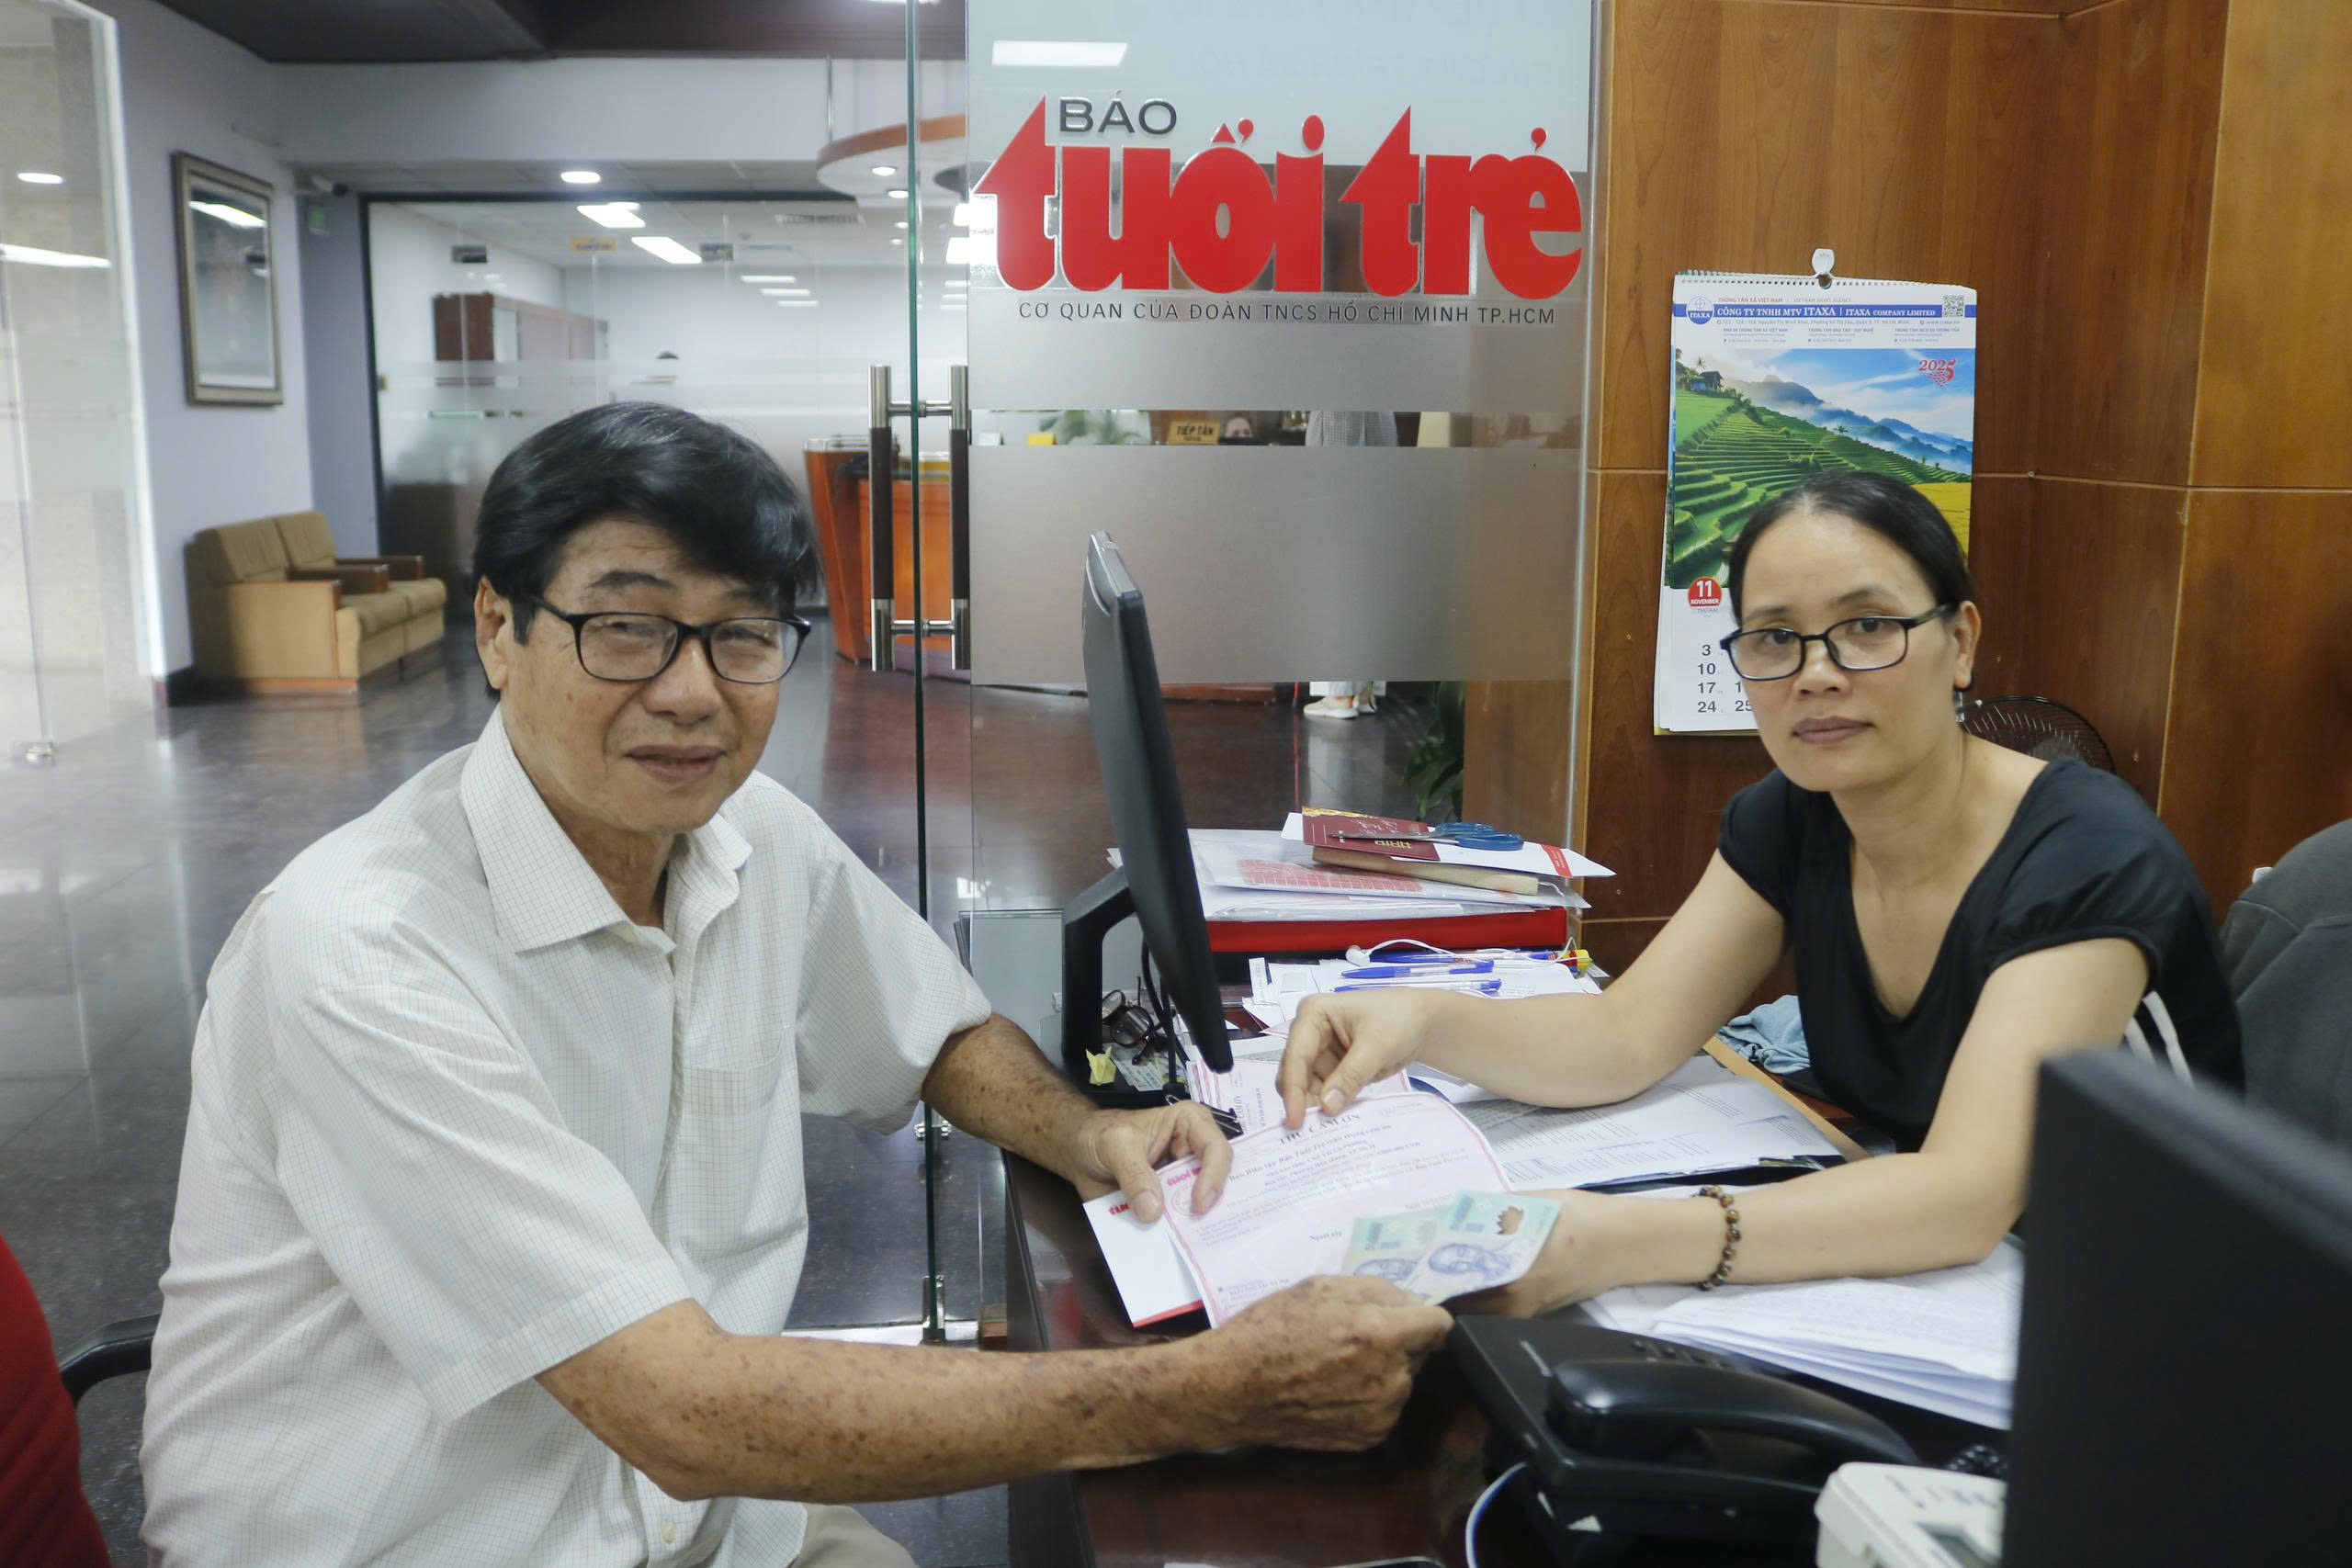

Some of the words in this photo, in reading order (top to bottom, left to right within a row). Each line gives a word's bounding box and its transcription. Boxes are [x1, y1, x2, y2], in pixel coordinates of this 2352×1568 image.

[1058, 90, 1177, 135] BÁO
[973, 95, 1325, 293] tuổi
[1339, 105, 1582, 299] trẻ
[1018, 301, 1049, 319] CƠ
[1060, 302, 1123, 321] QUAN
[1133, 299, 1179, 320] CỦA
[1189, 299, 1251, 321] ĐOÀN
[1261, 303, 1317, 321] TNCS
[1329, 299, 1358, 321] HỒ
[1367, 302, 1404, 321] CHÍ
[1413, 305, 1469, 322] MINH
[1477, 307, 1555, 324] TP.HCM
[1717, 306, 1742, 316] CÔNG
[1744, 308, 1756, 316] TY
[1757, 308, 1782, 316] TNHH
[1804, 307, 1836, 316] ITAXA
[1918, 359, 1957, 382] 2025
[1696, 581, 1713, 597] 11
[1702, 644, 1712, 657] 3
[1698, 663, 1716, 675] 10
[1698, 682, 1716, 694] 17
[1698, 701, 1717, 713] 24
